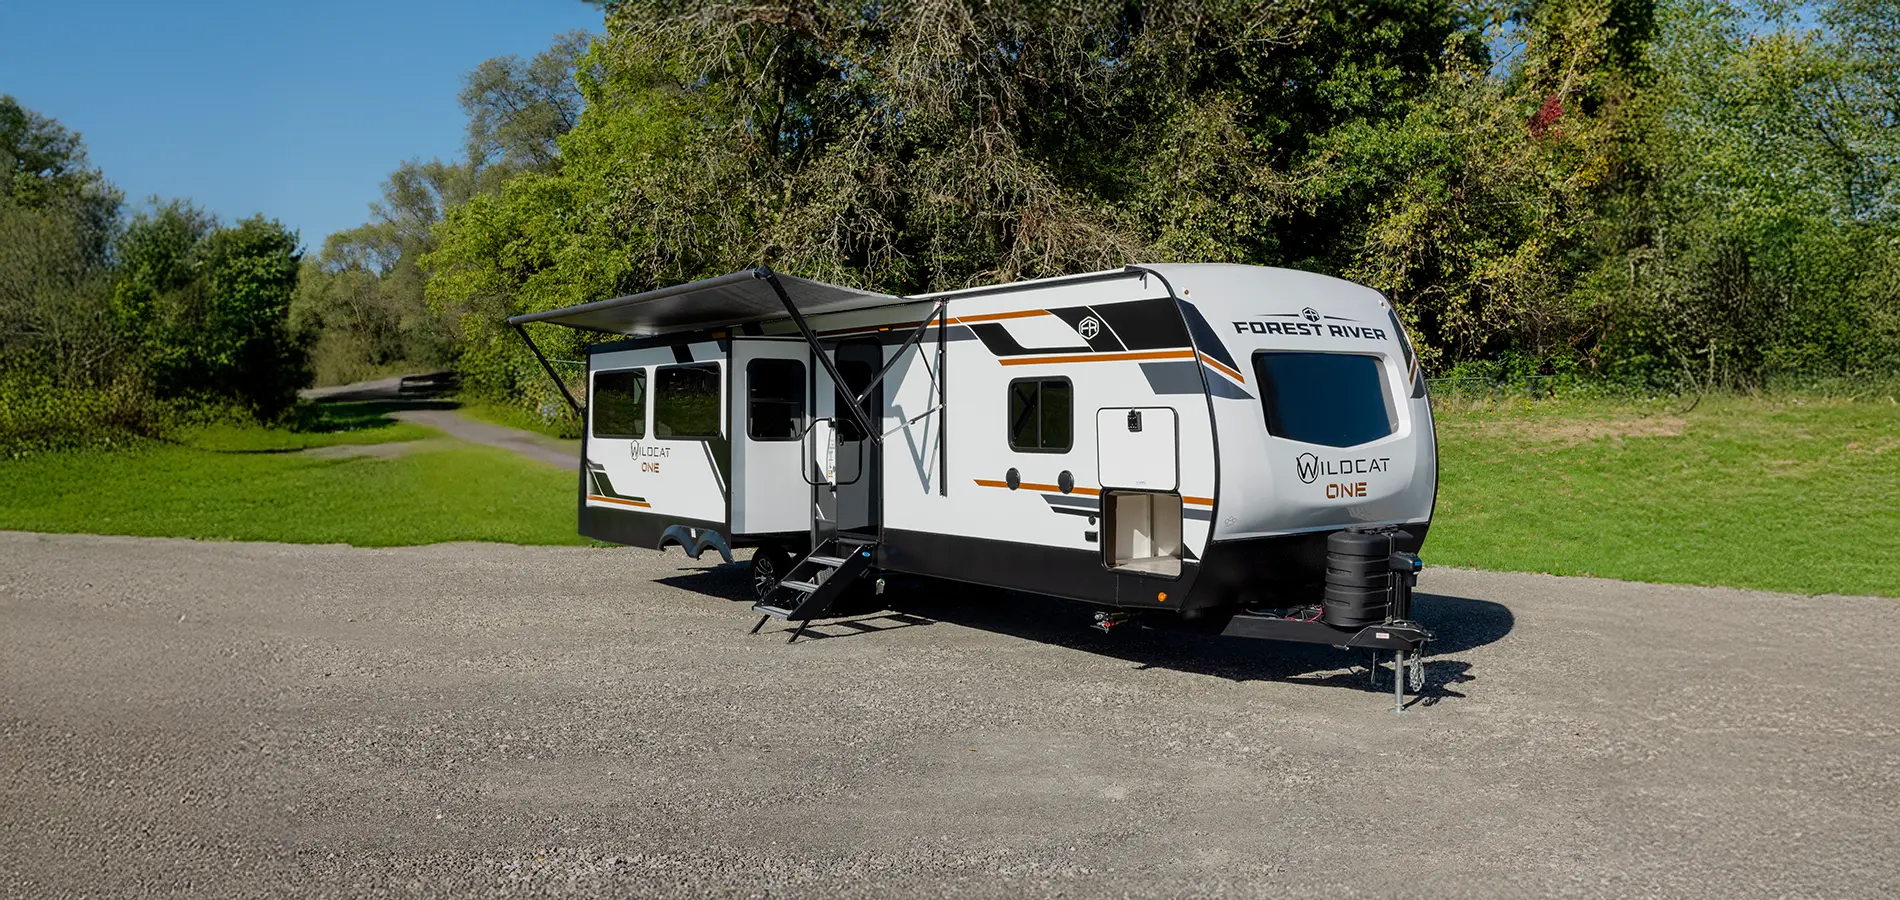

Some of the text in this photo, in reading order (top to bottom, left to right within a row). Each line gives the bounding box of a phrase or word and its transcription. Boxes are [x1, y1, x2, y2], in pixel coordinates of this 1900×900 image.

[1232, 321, 1388, 341] FOREST RIVER
[630, 440, 671, 460] WILDCAT
[641, 462, 660, 473] ONE
[1296, 452, 1390, 484] WILDCAT
[1326, 482, 1367, 499] ONE
